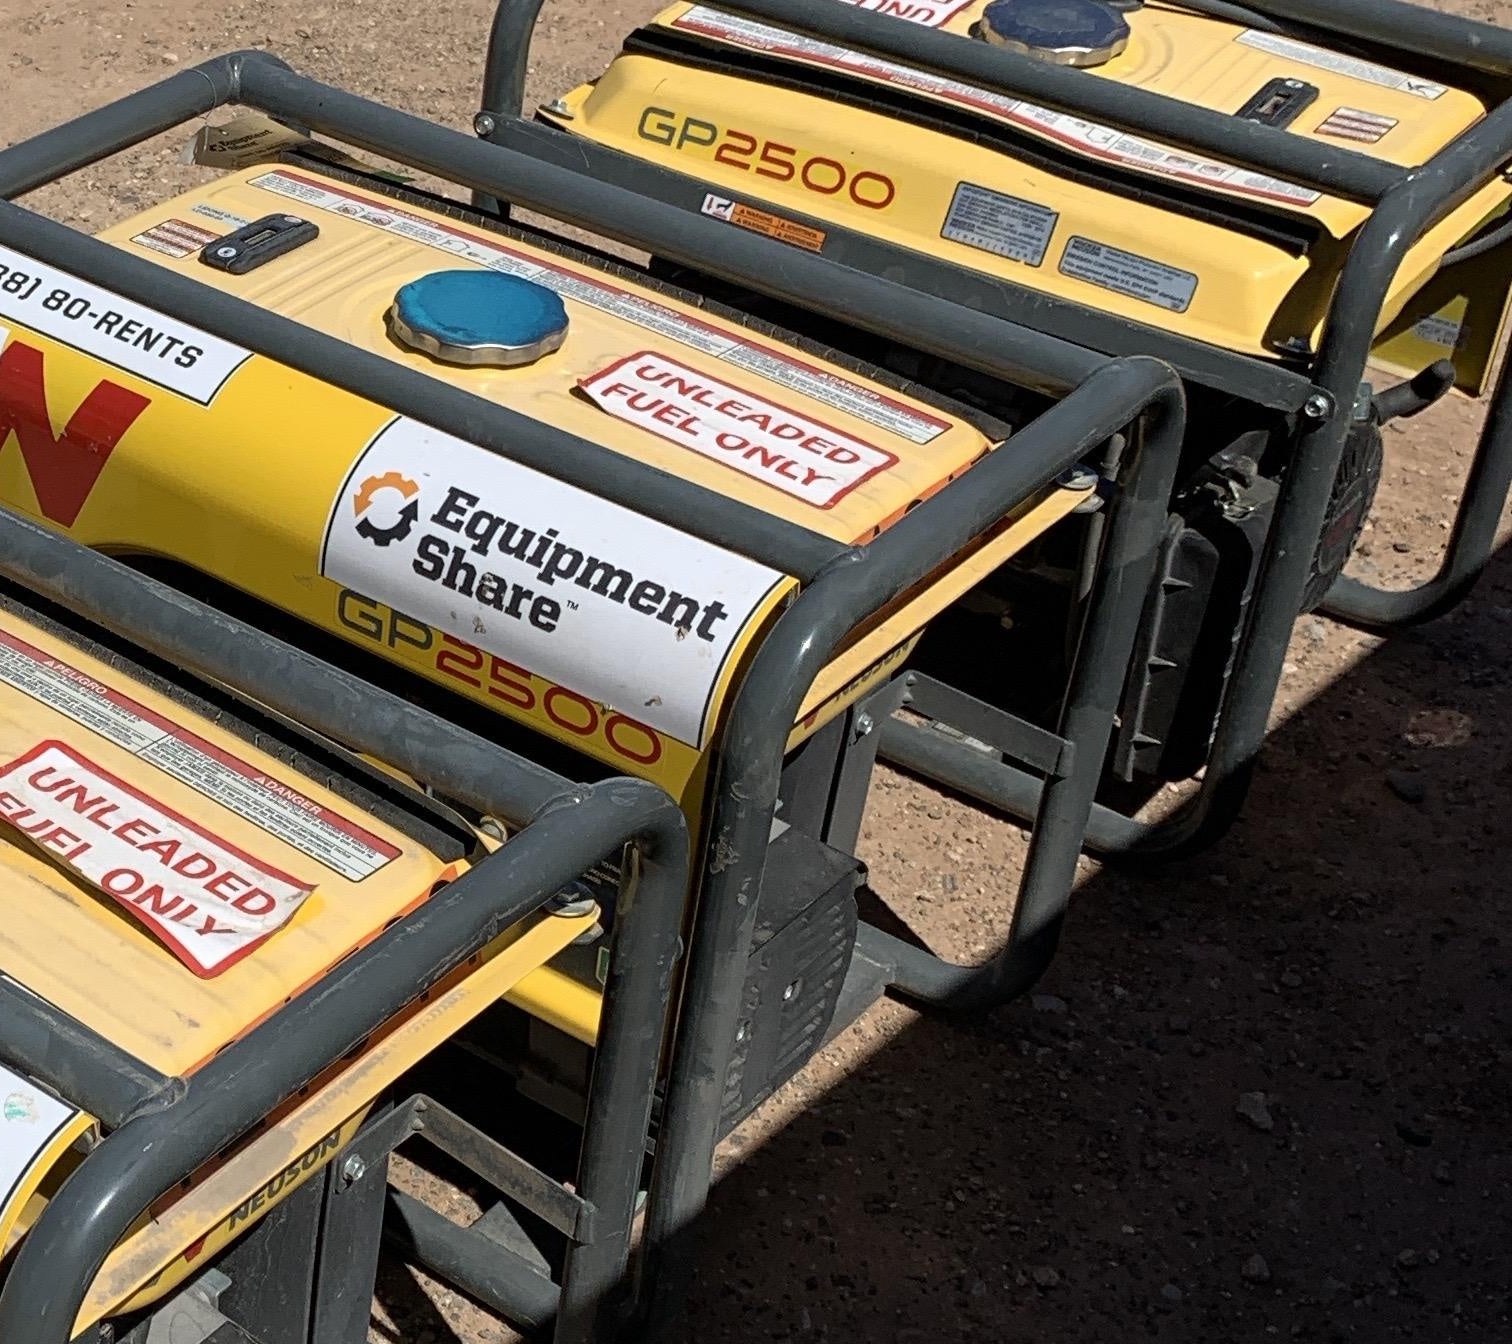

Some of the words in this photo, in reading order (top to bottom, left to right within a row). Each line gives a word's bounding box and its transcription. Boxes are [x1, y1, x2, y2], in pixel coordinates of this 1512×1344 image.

[637, 105, 896, 211] GP2500
[42, 287, 204, 370] 80-RENTS
[600, 381, 705, 437] FUEL
[715, 432, 837, 490] ONLY
[635, 361, 862, 467] UNLEADED
[412, 534, 561, 635] Share
[430, 486, 727, 642] Equipment
[55, 665, 108, 694] PELIGRO
[337, 588, 662, 765] GP2500
[27, 766, 277, 917] UNLEADED
[265, 777, 322, 816] DANGER
[101, 868, 239, 937] ONLY
[227, 1131, 342, 1232] NEUSON
